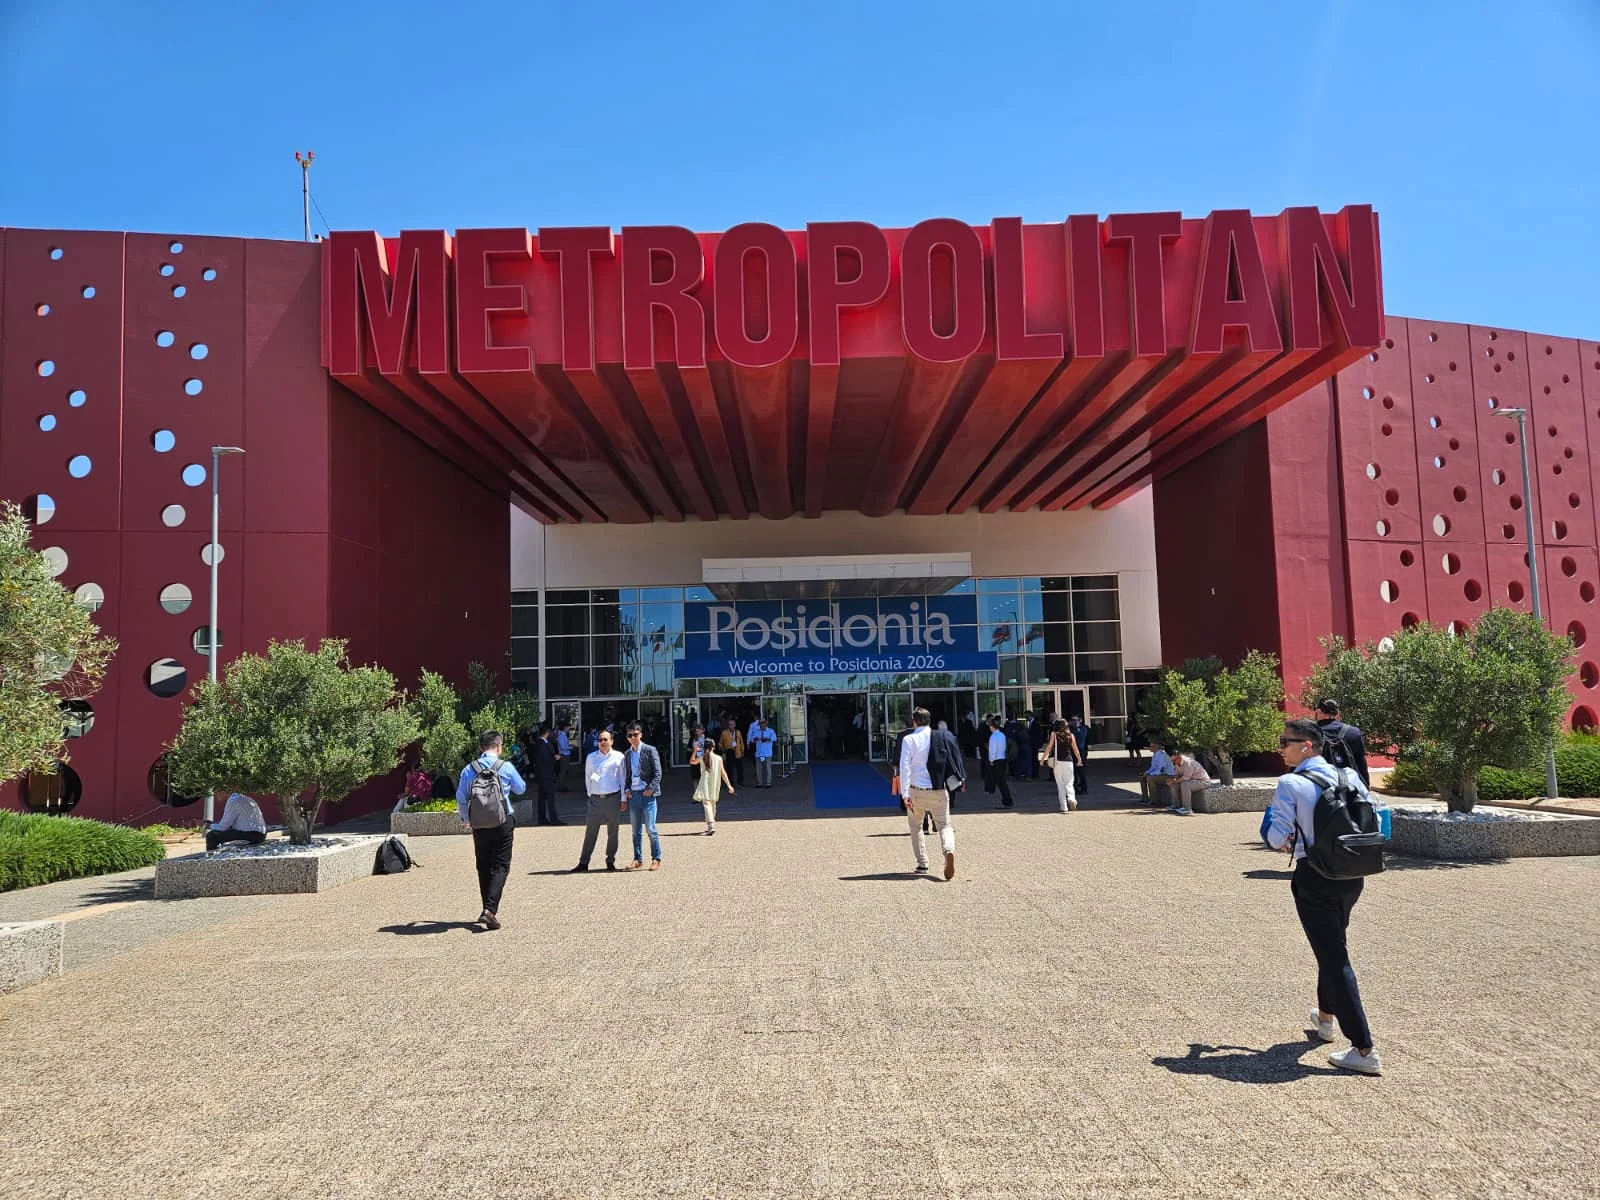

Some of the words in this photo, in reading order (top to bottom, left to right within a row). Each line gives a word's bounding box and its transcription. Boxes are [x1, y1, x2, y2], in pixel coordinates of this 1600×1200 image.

[329, 204, 1378, 376] METROPOLITAN
[707, 602, 956, 652] Posidonia
[728, 660, 803, 674] Welcome
[807, 660, 824, 673] to
[829, 656, 902, 671] Posidonia
[907, 655, 945, 669] 2026
